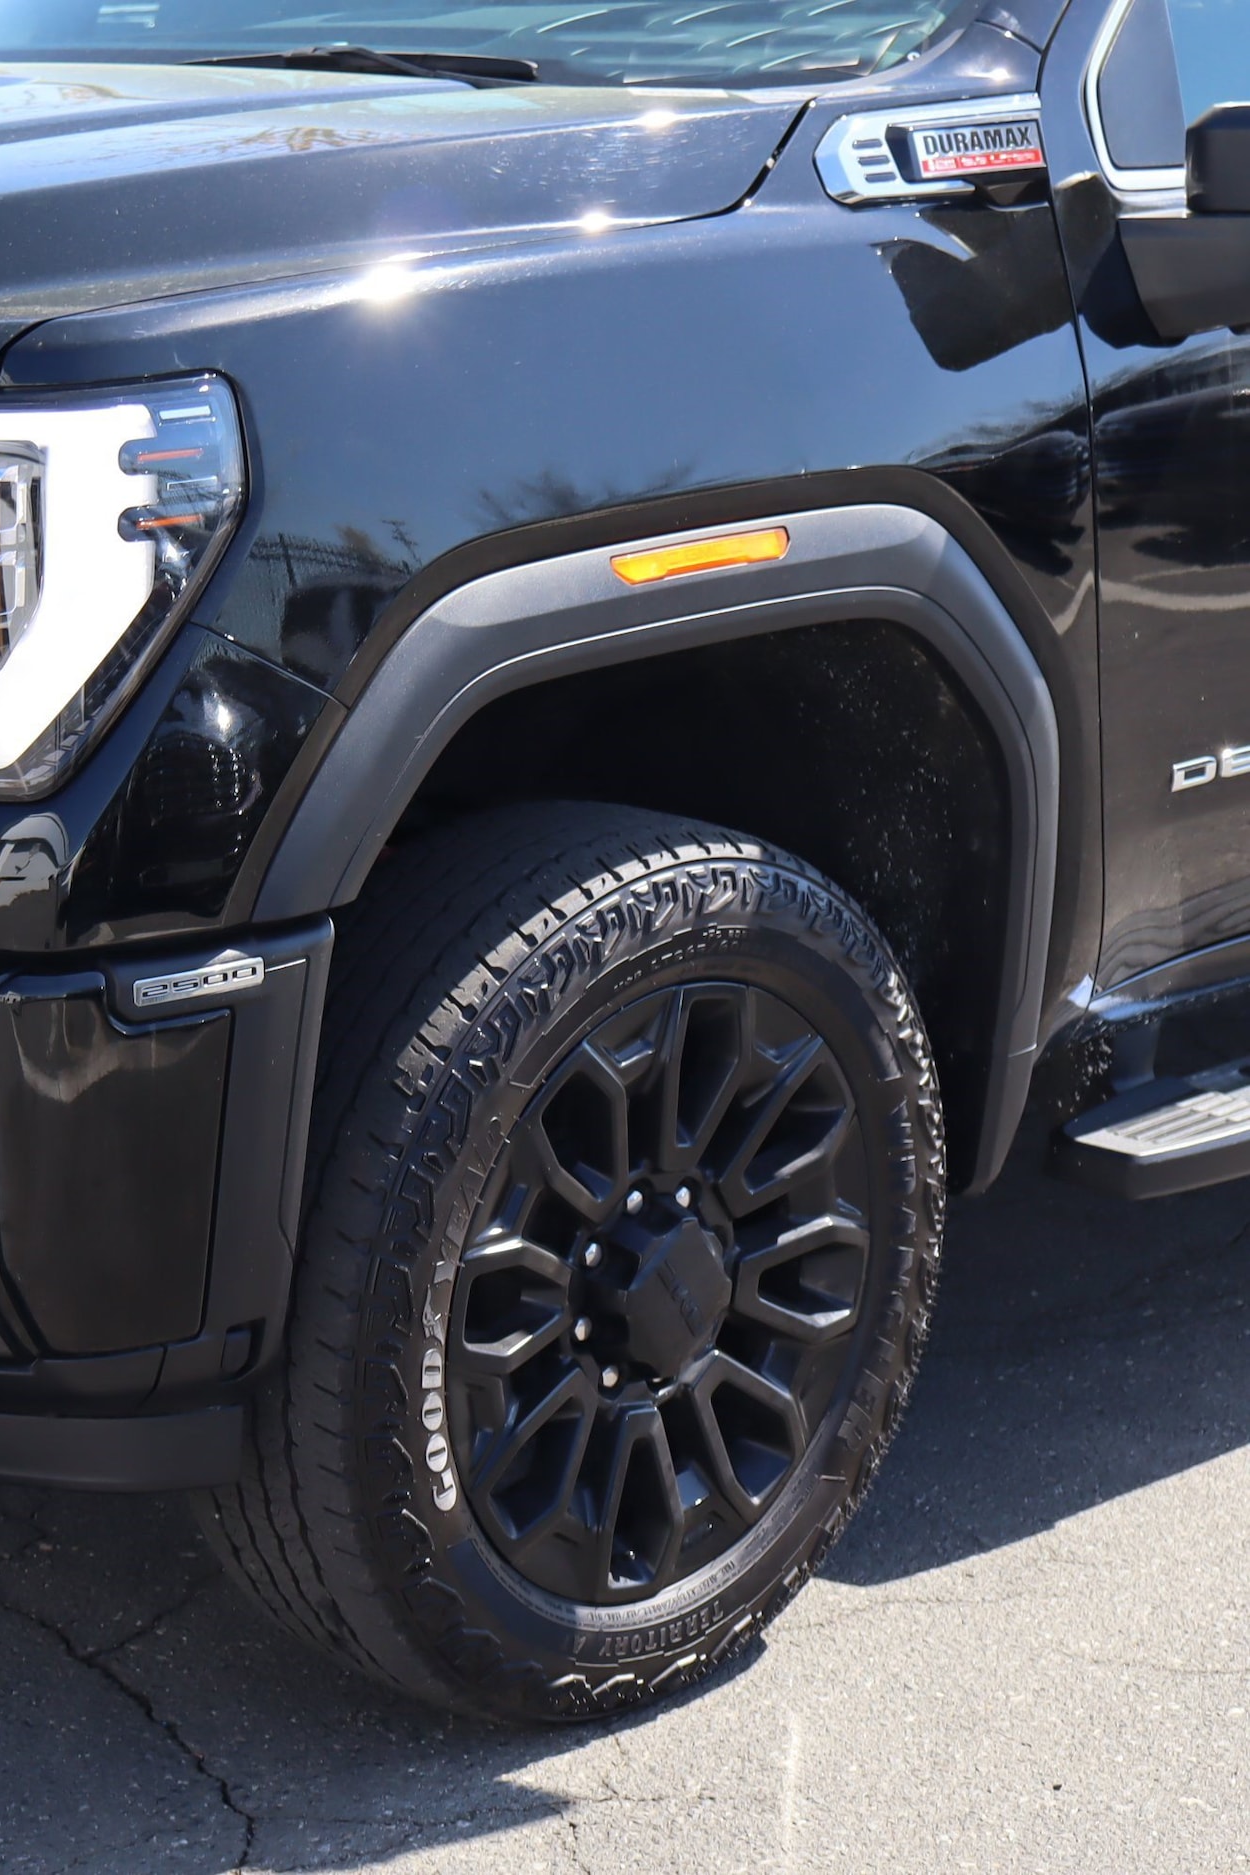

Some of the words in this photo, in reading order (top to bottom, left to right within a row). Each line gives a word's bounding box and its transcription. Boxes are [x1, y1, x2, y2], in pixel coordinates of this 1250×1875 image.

[923, 127, 1032, 154] DURAMAX
[141, 966, 257, 998] 2500
[598, 1600, 725, 1658] TERRITORY
